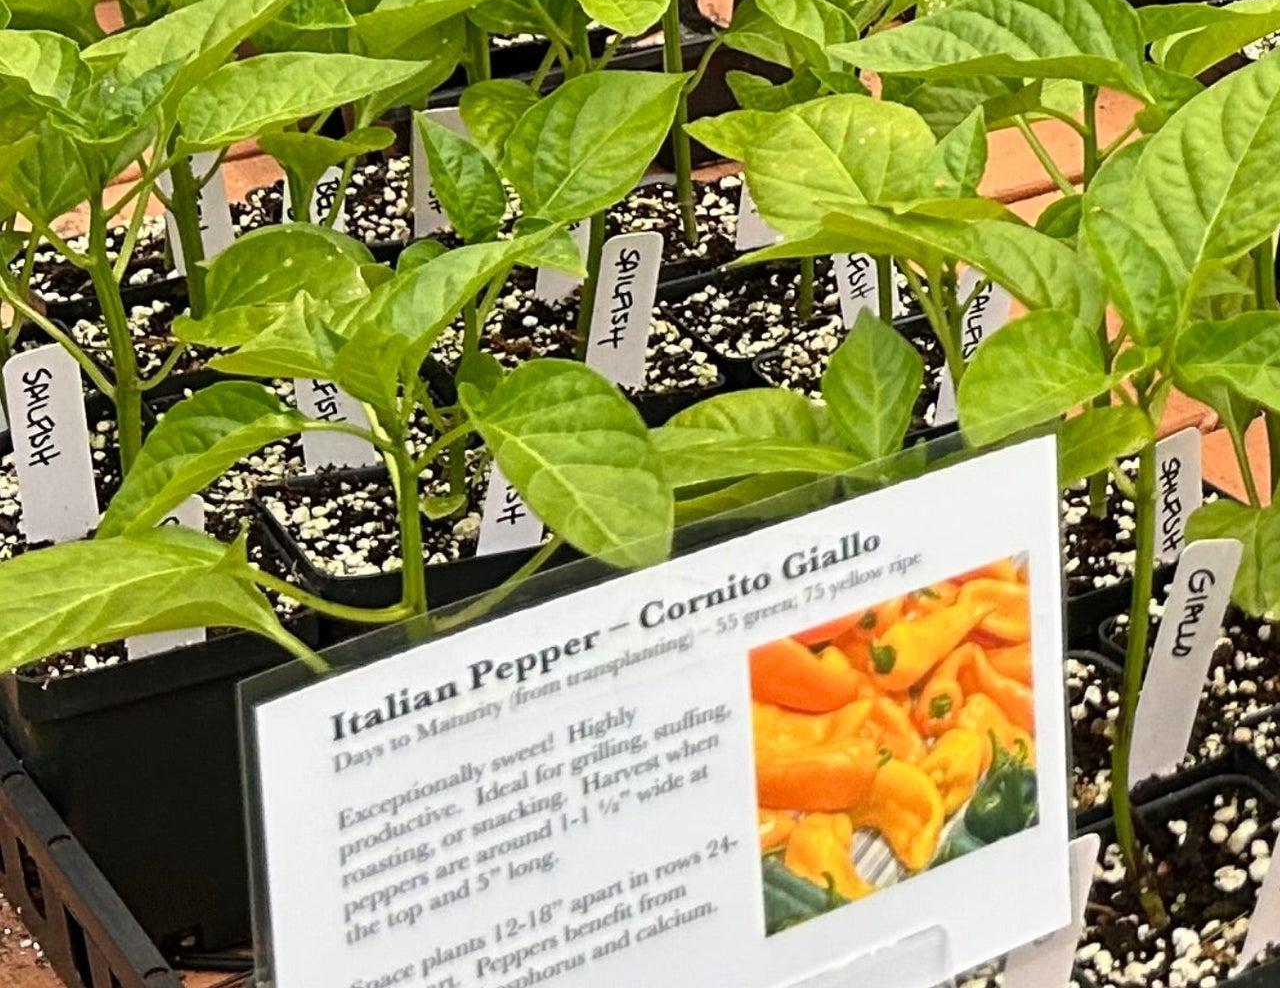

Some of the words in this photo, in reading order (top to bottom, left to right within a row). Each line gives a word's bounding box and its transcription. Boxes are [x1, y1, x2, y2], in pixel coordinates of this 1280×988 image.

[597, 248, 640, 349] SAILFISH
[847, 253, 876, 300] FISH
[962, 279, 992, 359] SAILFIS
[22, 367, 61, 468] SAILFISH
[1161, 457, 1185, 553] SAILFISH
[332, 682, 458, 741] Italian
[469, 630, 599, 690] Pepper
[639, 573, 771, 628] Cornito
[781, 532, 880, 580] Giallo
[332, 744, 384, 773] Days
[389, 733, 411, 751] to
[416, 701, 502, 741] Maturity
[715, 612, 738, 635] 55
[803, 581, 825, 603] 75
[829, 566, 883, 598] yellow
[887, 553, 922, 575] ripe
[1172, 568, 1216, 658] GIALLO
[337, 763, 484, 830] Exceptionally
[490, 732, 554, 772] sweet!
[567, 707, 635, 743] Highly
[338, 804, 461, 861] productive.
[475, 770, 528, 806] Ideal
[534, 762, 564, 784] for
[570, 734, 647, 775] grilling,
[653, 704, 731, 740] stuffing,
[340, 842, 435, 889] roasting,
[440, 827, 466, 848] or
[471, 792, 567, 836] snacking.
[581, 755, 660, 795] Harvest
[665, 734, 719, 763] when
[343, 873, 429, 920] peppers
[434, 856, 469, 880] are
[475, 819, 552, 863] around
[636, 772, 684, 803] wide
[689, 763, 709, 784] at
[344, 910, 380, 946] the
[386, 903, 423, 928] top
[428, 878, 470, 911] and
[507, 851, 559, 880] long.
[421, 936, 486, 976] plants
[569, 880, 623, 914] apart
[628, 871, 649, 890] in
[654, 851, 701, 880] rows
[475, 936, 558, 978] Peppers
[563, 902, 632, 942] benefit
[638, 884, 687, 913] from
[591, 928, 630, 960] and
[635, 902, 717, 942] calcium.
